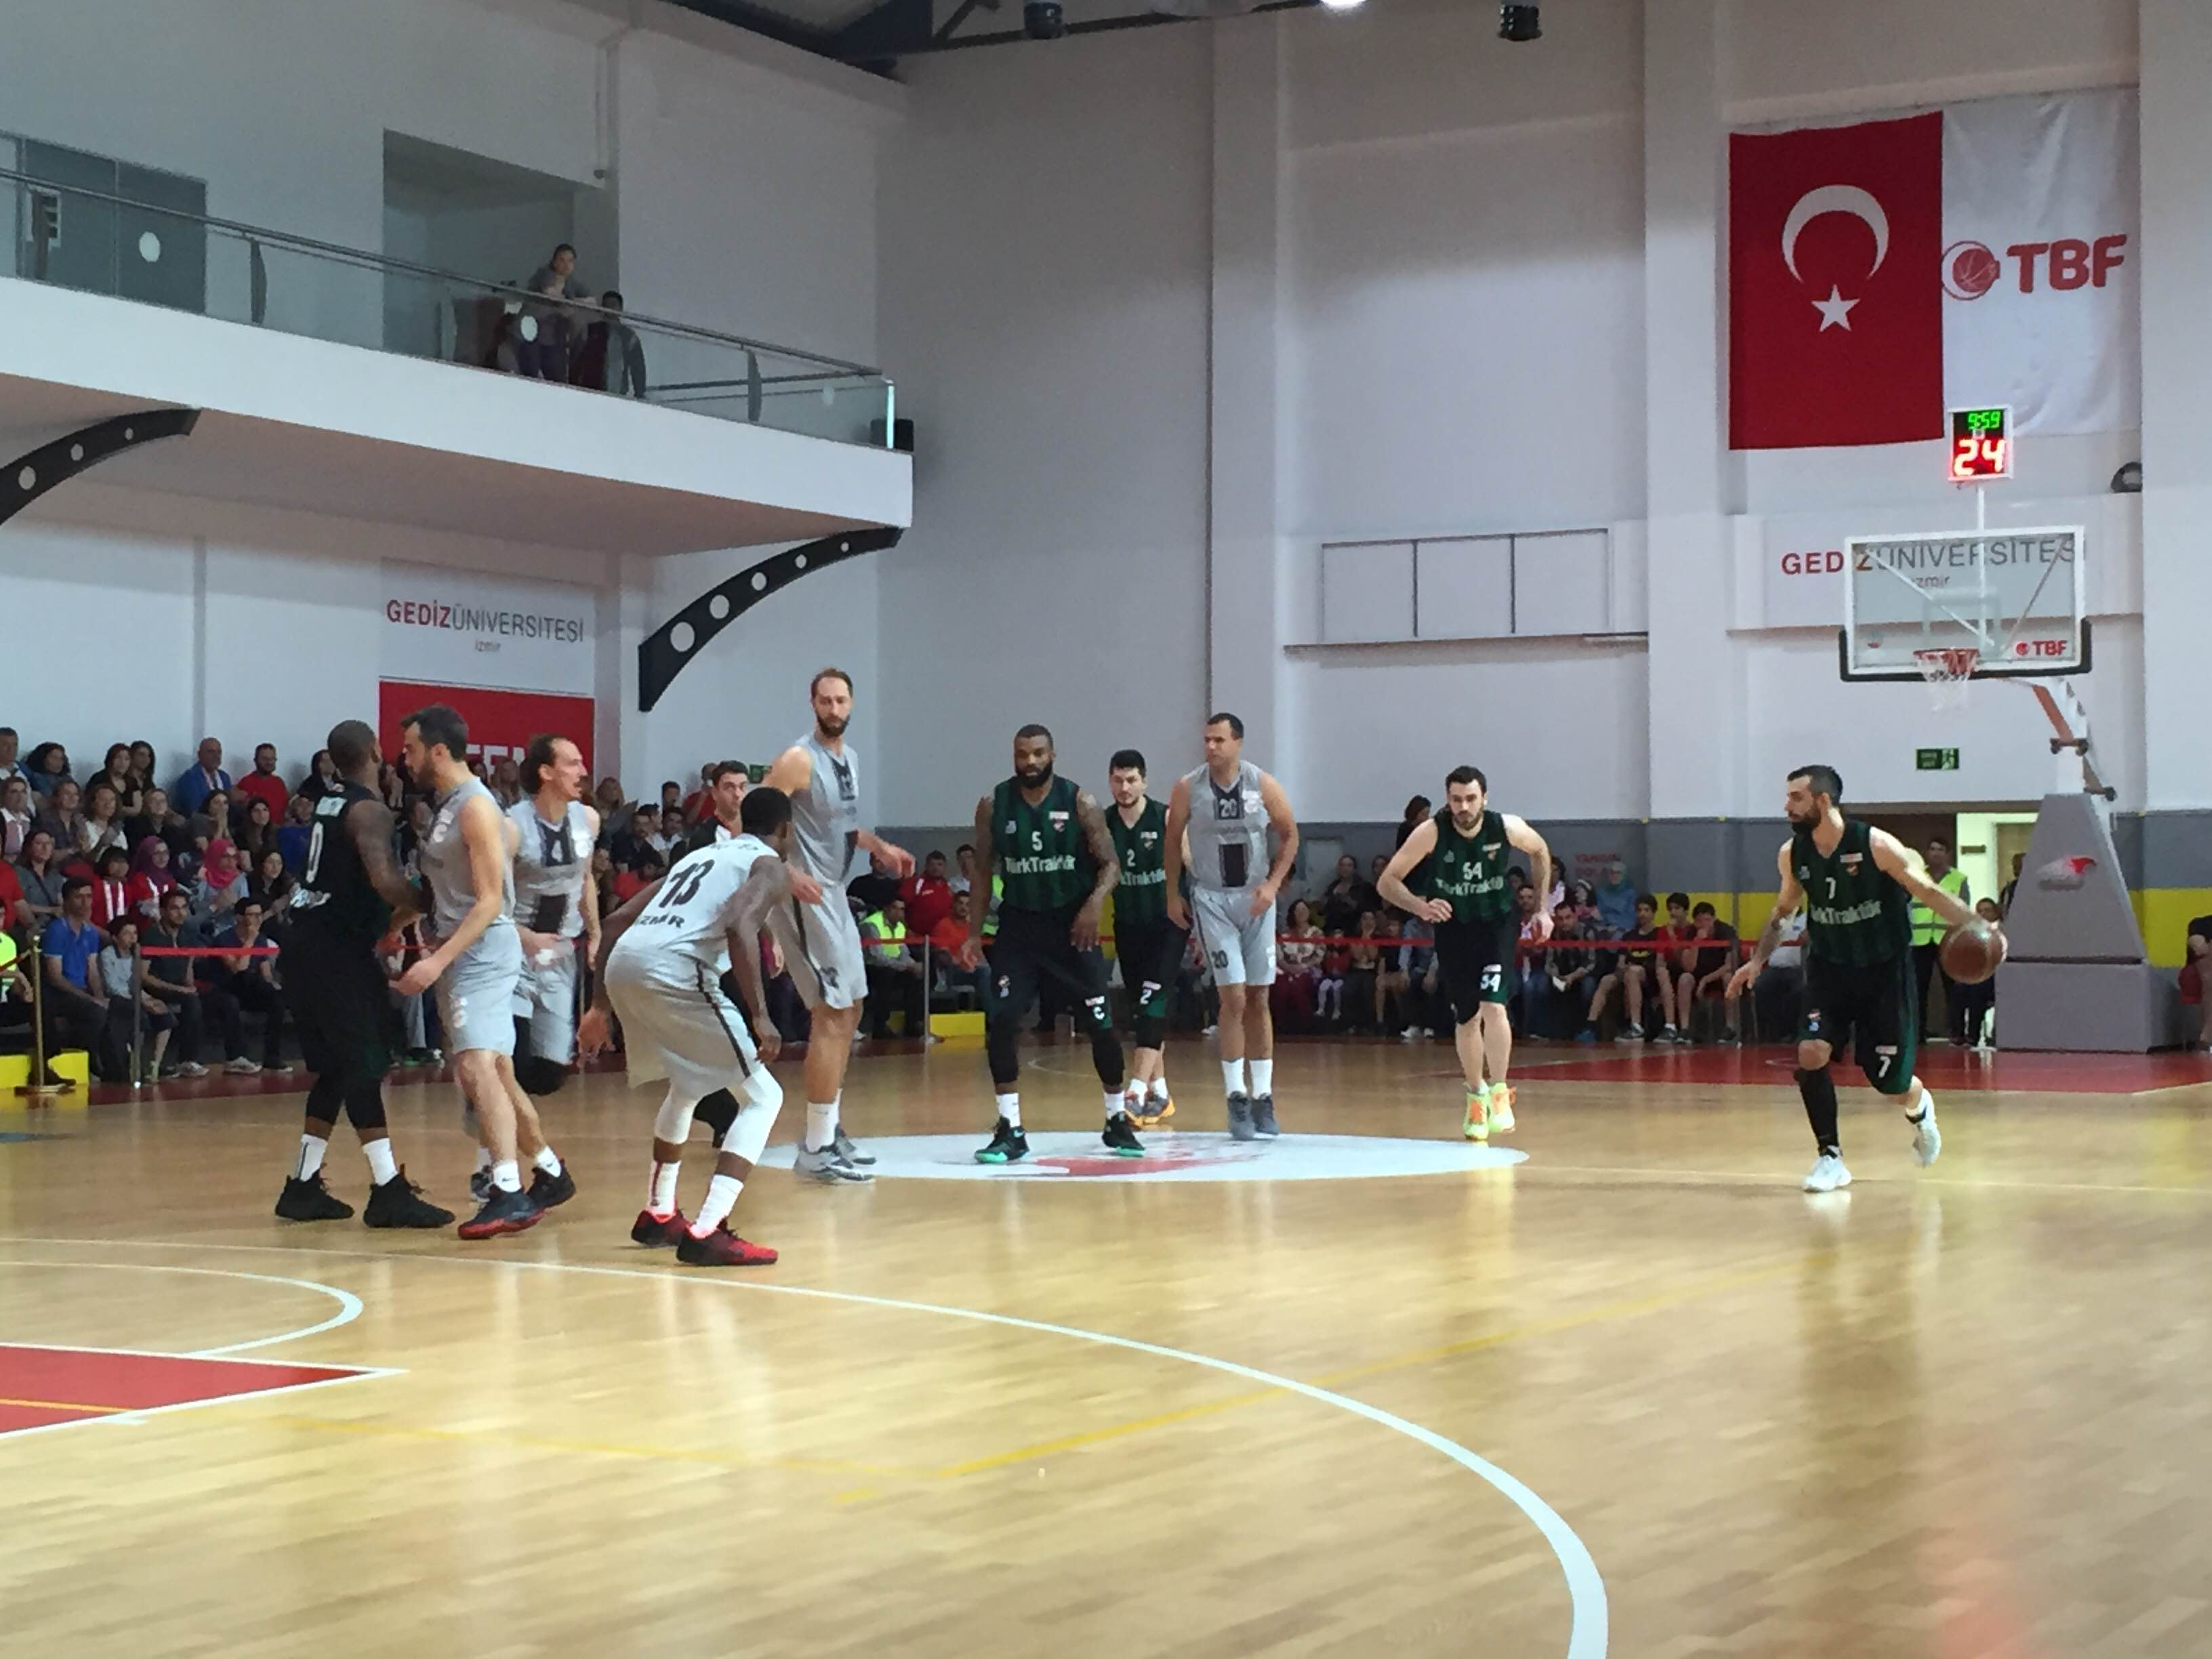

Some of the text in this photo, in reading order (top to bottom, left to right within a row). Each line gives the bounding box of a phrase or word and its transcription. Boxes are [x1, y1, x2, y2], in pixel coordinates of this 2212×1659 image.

[2006, 234, 2127, 293] TBF
[1954, 438, 2007, 476] 24
[2032, 640, 2068, 657] TBF
[1031, 830, 1044, 852] 5
[1127, 848, 1136, 867] 2
[1462, 861, 1483, 881] 54
[658, 859, 716, 909] 13
[1825, 876, 1837, 900] 7
[1878, 1055, 1891, 1079] 7
